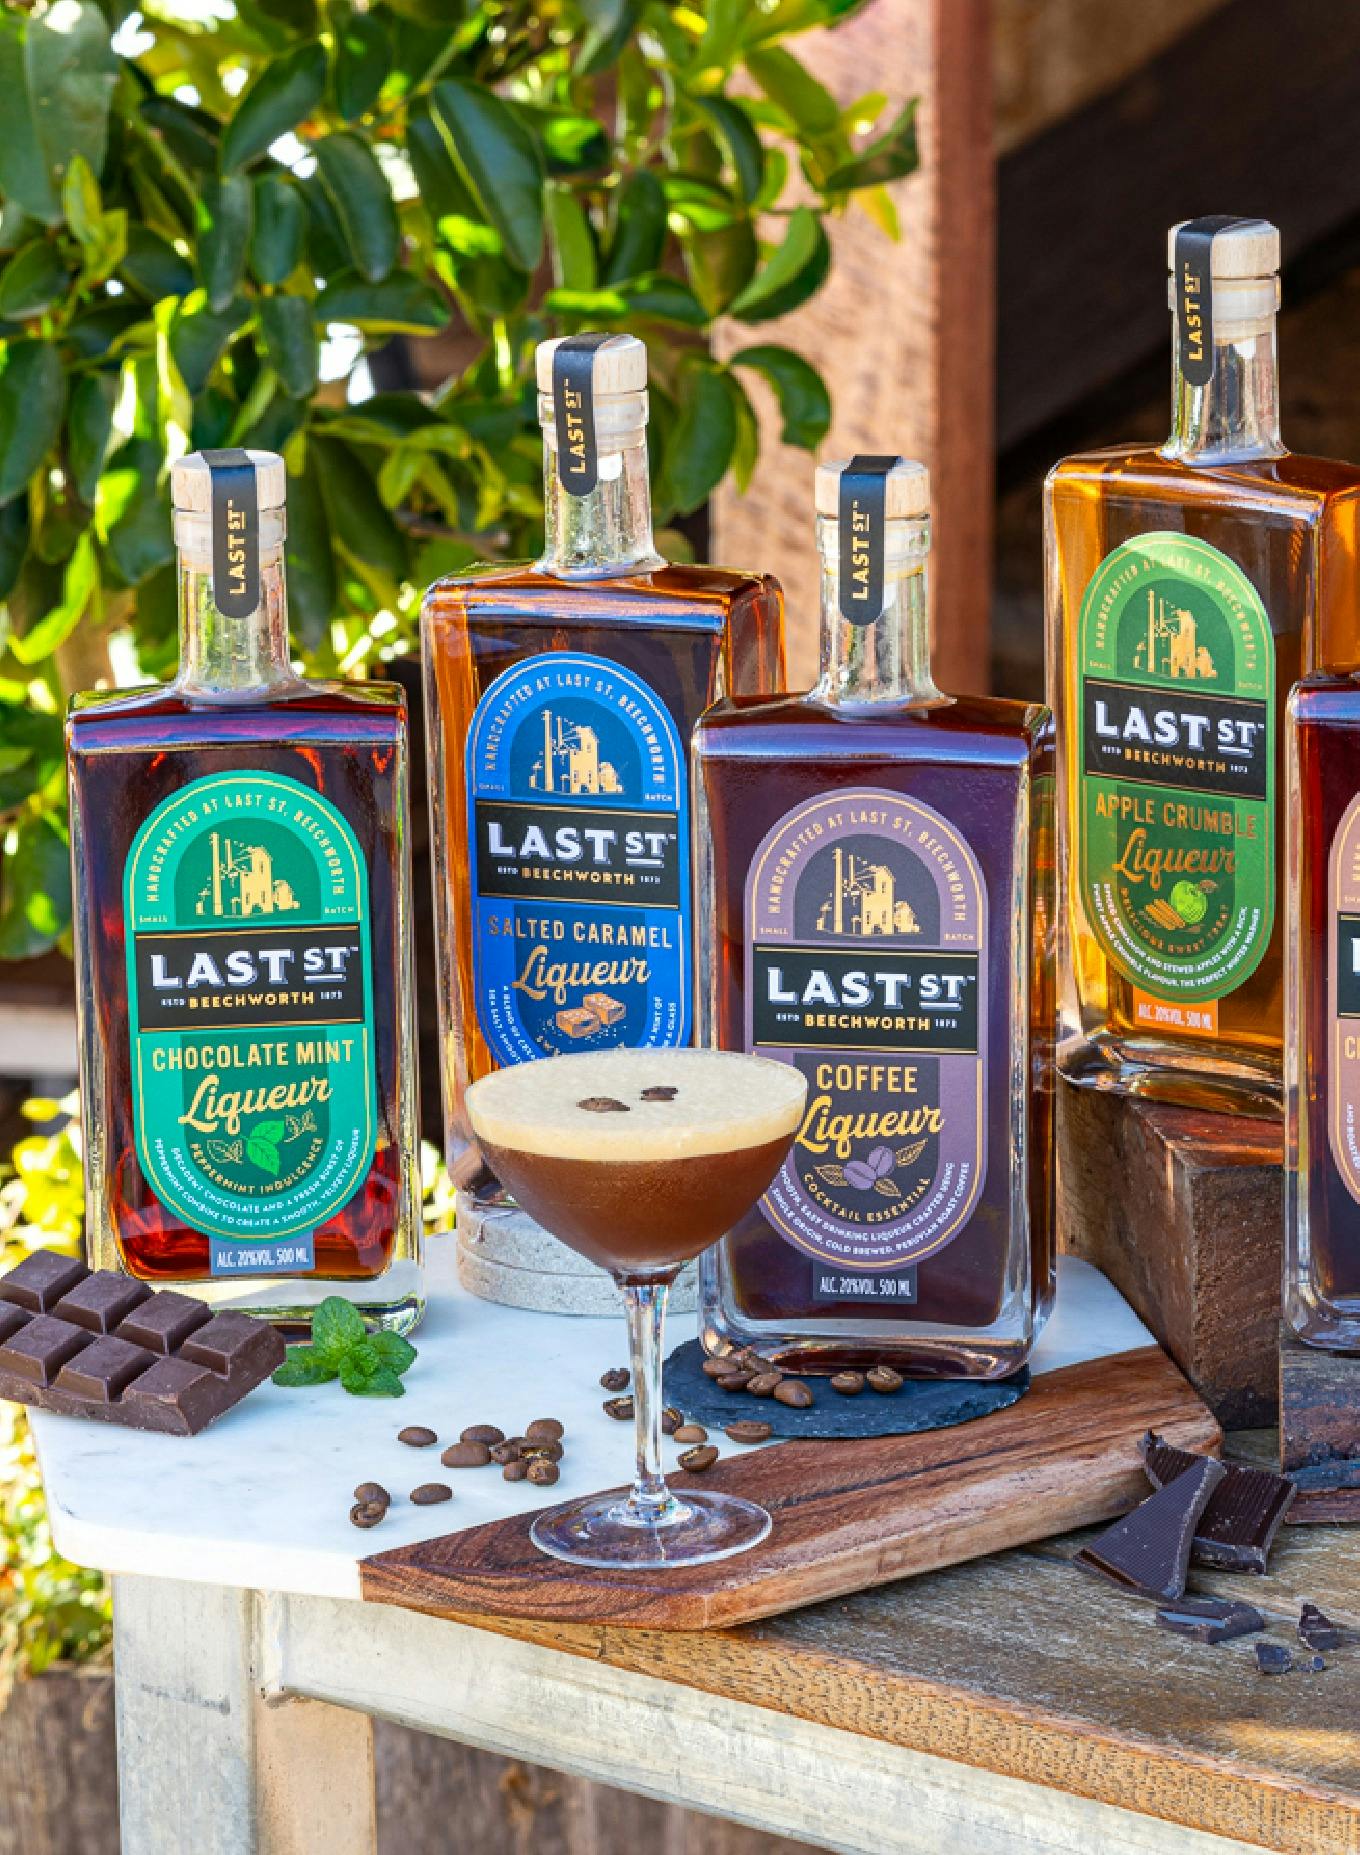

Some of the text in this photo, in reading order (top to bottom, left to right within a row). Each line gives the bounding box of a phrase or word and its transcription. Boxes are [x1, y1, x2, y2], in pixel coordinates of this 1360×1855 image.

[1184, 297, 1203, 362] LAST
[567, 412, 586, 474] LAST
[228, 534, 247, 594] LAST
[852, 536, 870, 601] LAST
[536, 675, 551, 692] AT
[556, 673, 591, 688] LAST
[1094, 700, 1211, 751] LAST
[1124, 747, 1227, 773] BEECHWORTH
[202, 798, 218, 815] AT
[224, 793, 262, 808] LAST
[827, 812, 843, 830] AT
[850, 810, 888, 824] LAST
[1095, 792, 1257, 839] APPLE CRUMBLE
[486, 821, 617, 865] LAST
[1111, 828, 1237, 890] Liqueur
[520, 866, 636, 885] BEECHWORTH
[487, 914, 673, 949] SALTED CARAMEL
[150, 949, 294, 990] LAST
[511, 944, 652, 1005] Liqueur
[767, 966, 912, 1010] LAST
[187, 991, 315, 1009] BEECHWORTH
[804, 1013, 931, 1031] BEECHWORTH
[152, 1039, 354, 1072] CHOCOLATE MINT
[815, 1063, 918, 1093] COFFEE
[177, 1073, 333, 1135] Liqueur
[794, 1095, 945, 1159] Liqueur
[190, 1142, 256, 1195] PEPPERMINT
[804, 1173, 860, 1221] COCKTAIL
[276, 1248, 294, 1265] 500
[879, 1278, 897, 1296] 500
